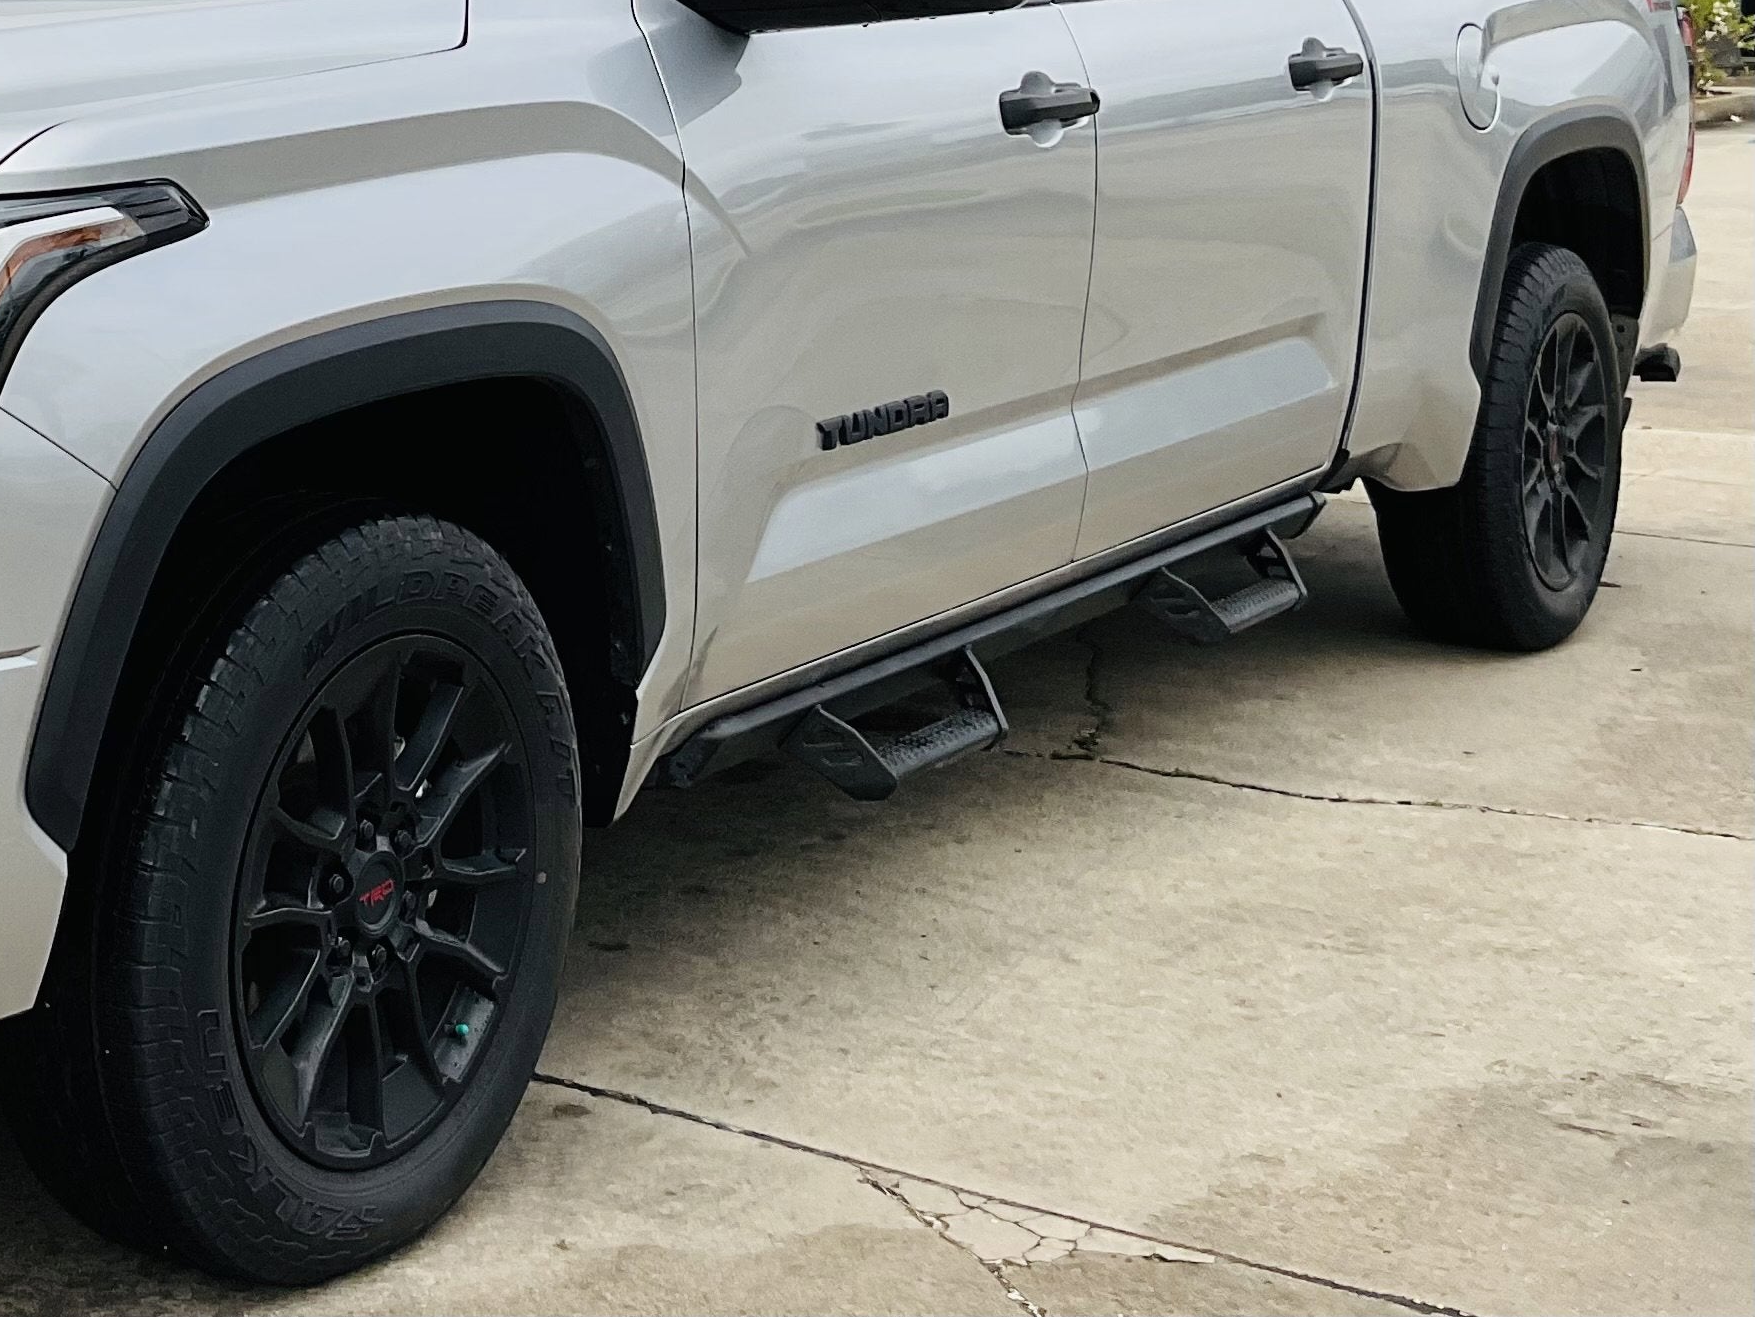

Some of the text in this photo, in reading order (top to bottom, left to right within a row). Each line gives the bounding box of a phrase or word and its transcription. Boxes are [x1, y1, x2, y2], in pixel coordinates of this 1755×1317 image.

[815, 389, 950, 451] TUNDRA
[302, 568, 553, 680] WILDPEAK
[357, 877, 395, 908] TRD
[196, 1008, 385, 1241] FALKEN
